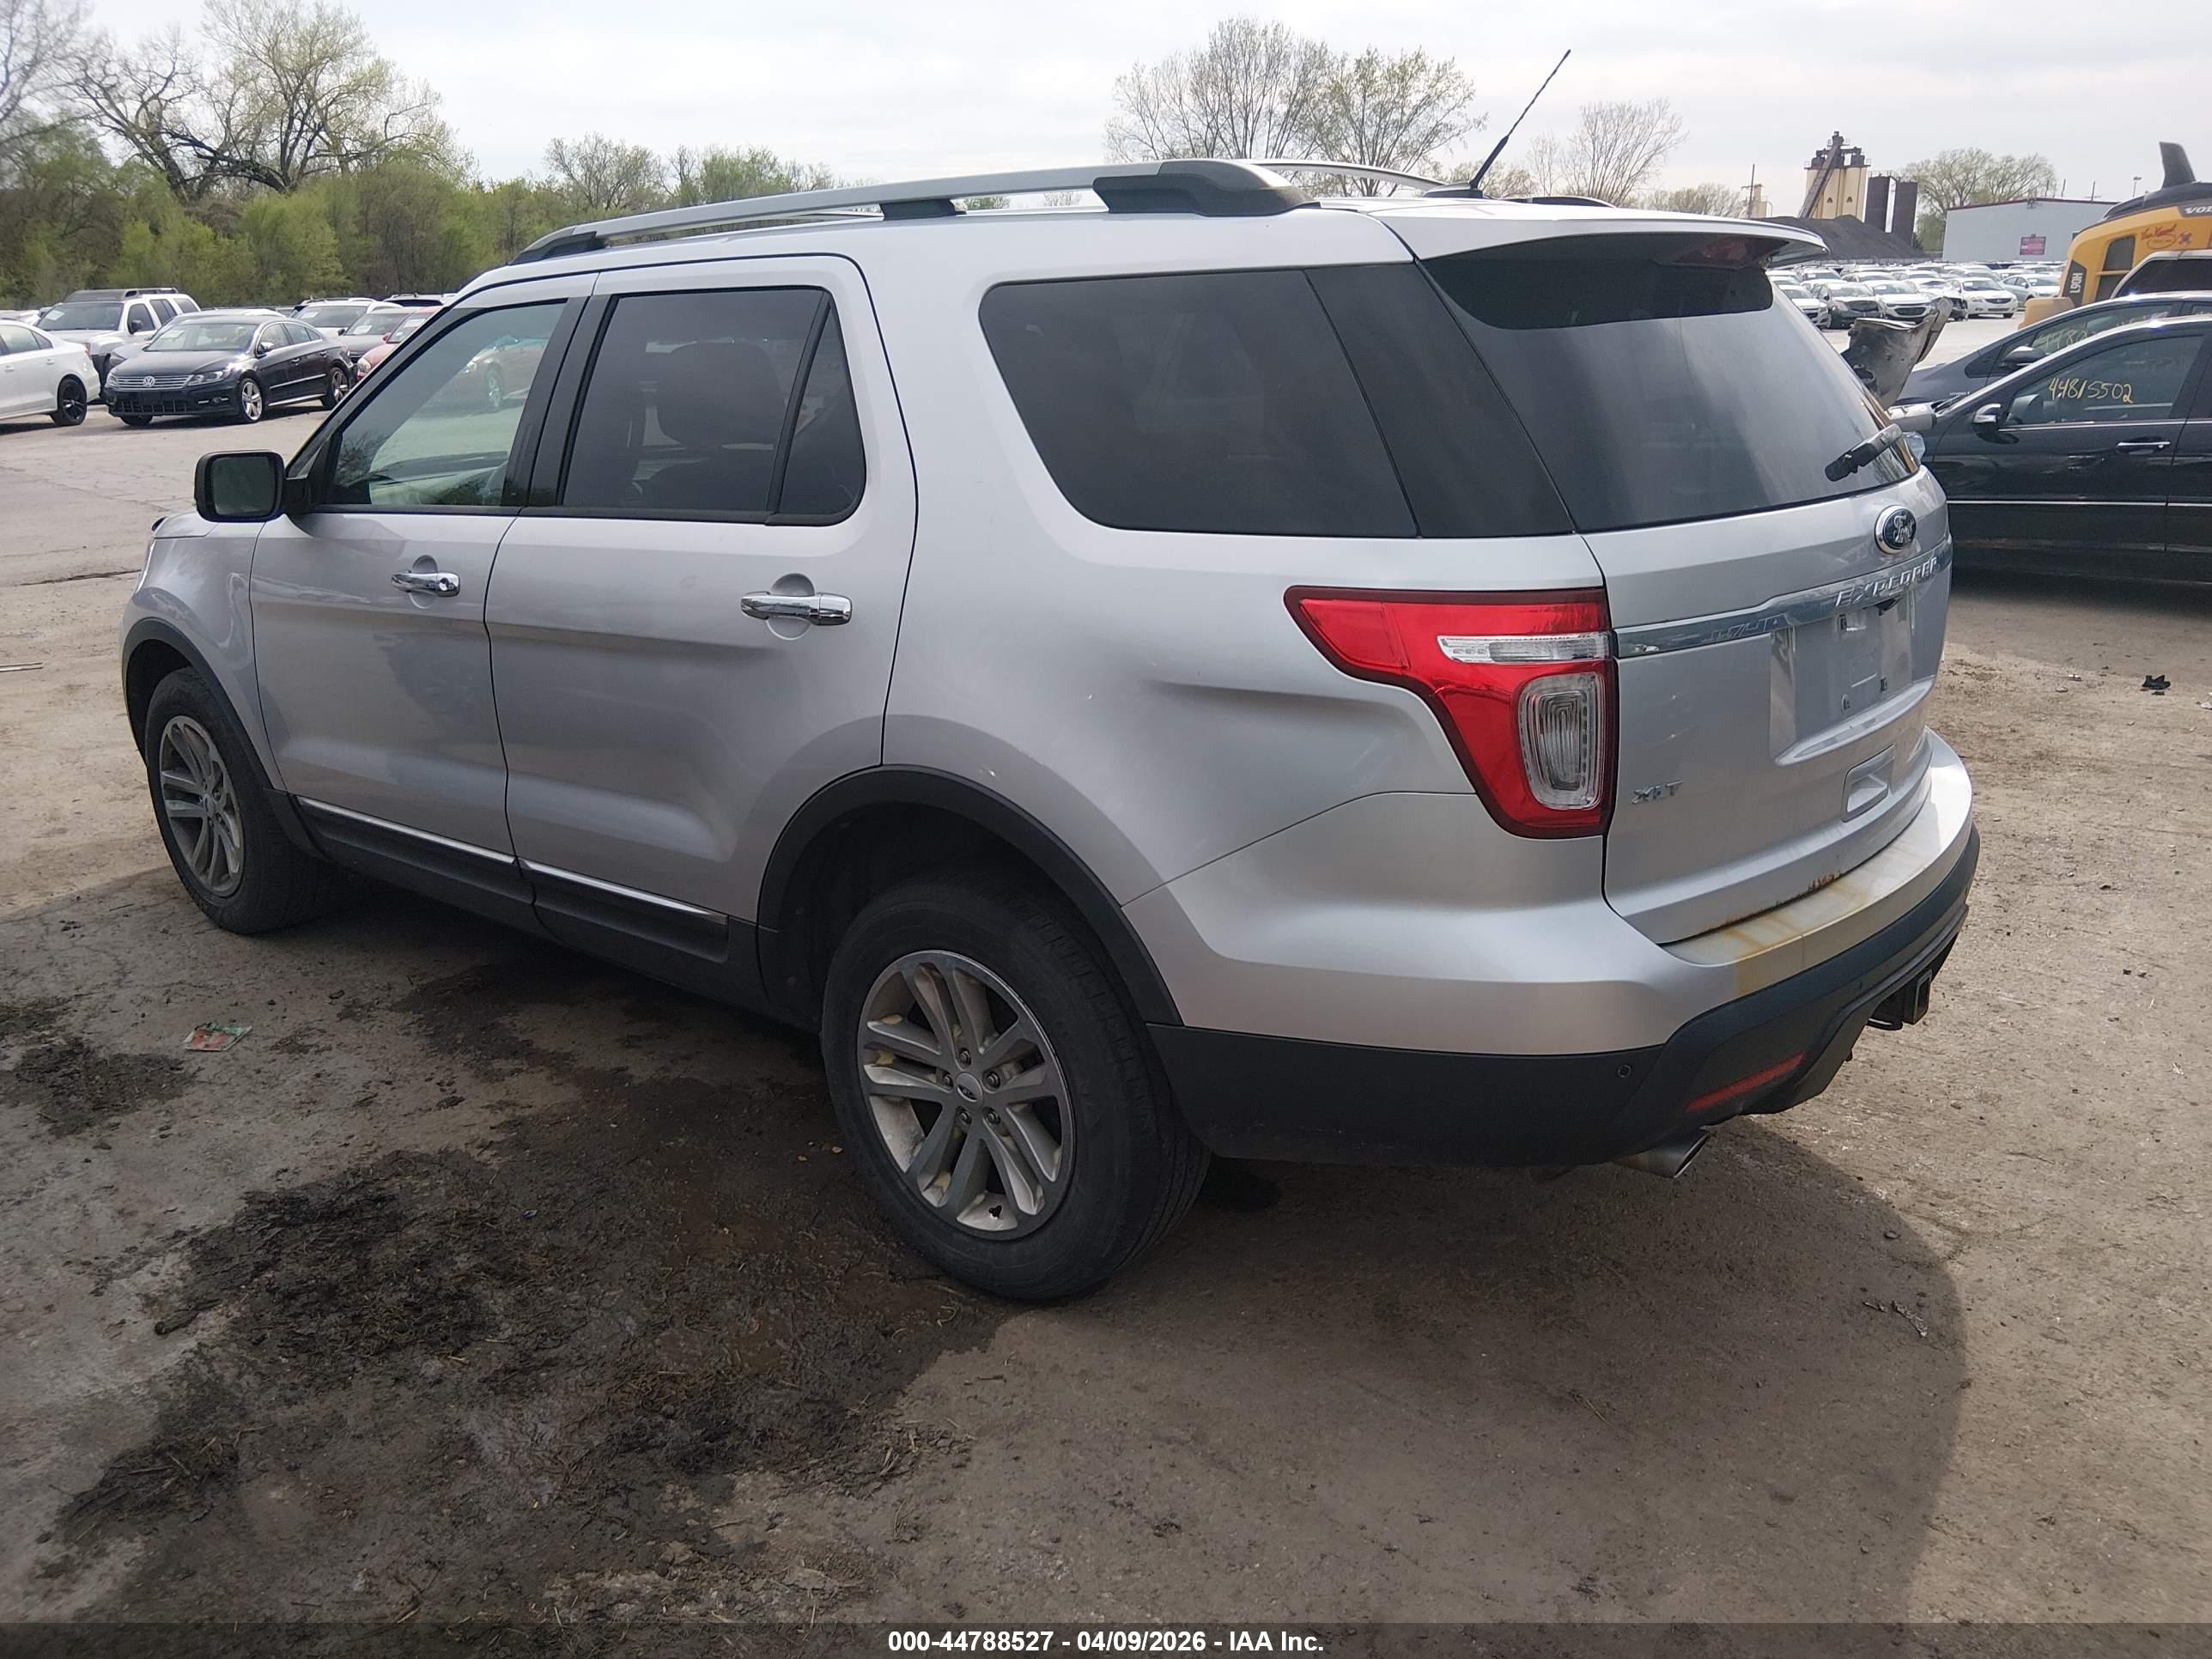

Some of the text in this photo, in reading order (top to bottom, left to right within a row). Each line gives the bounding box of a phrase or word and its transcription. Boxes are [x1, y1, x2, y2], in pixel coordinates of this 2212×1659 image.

[2069, 272, 2083, 294] L90H
[2049, 378, 2134, 404] 44815502
[1892, 514, 1915, 544] Ford
[1835, 556, 1938, 607] EXPLORER
[1631, 780, 1684, 805] XLT
